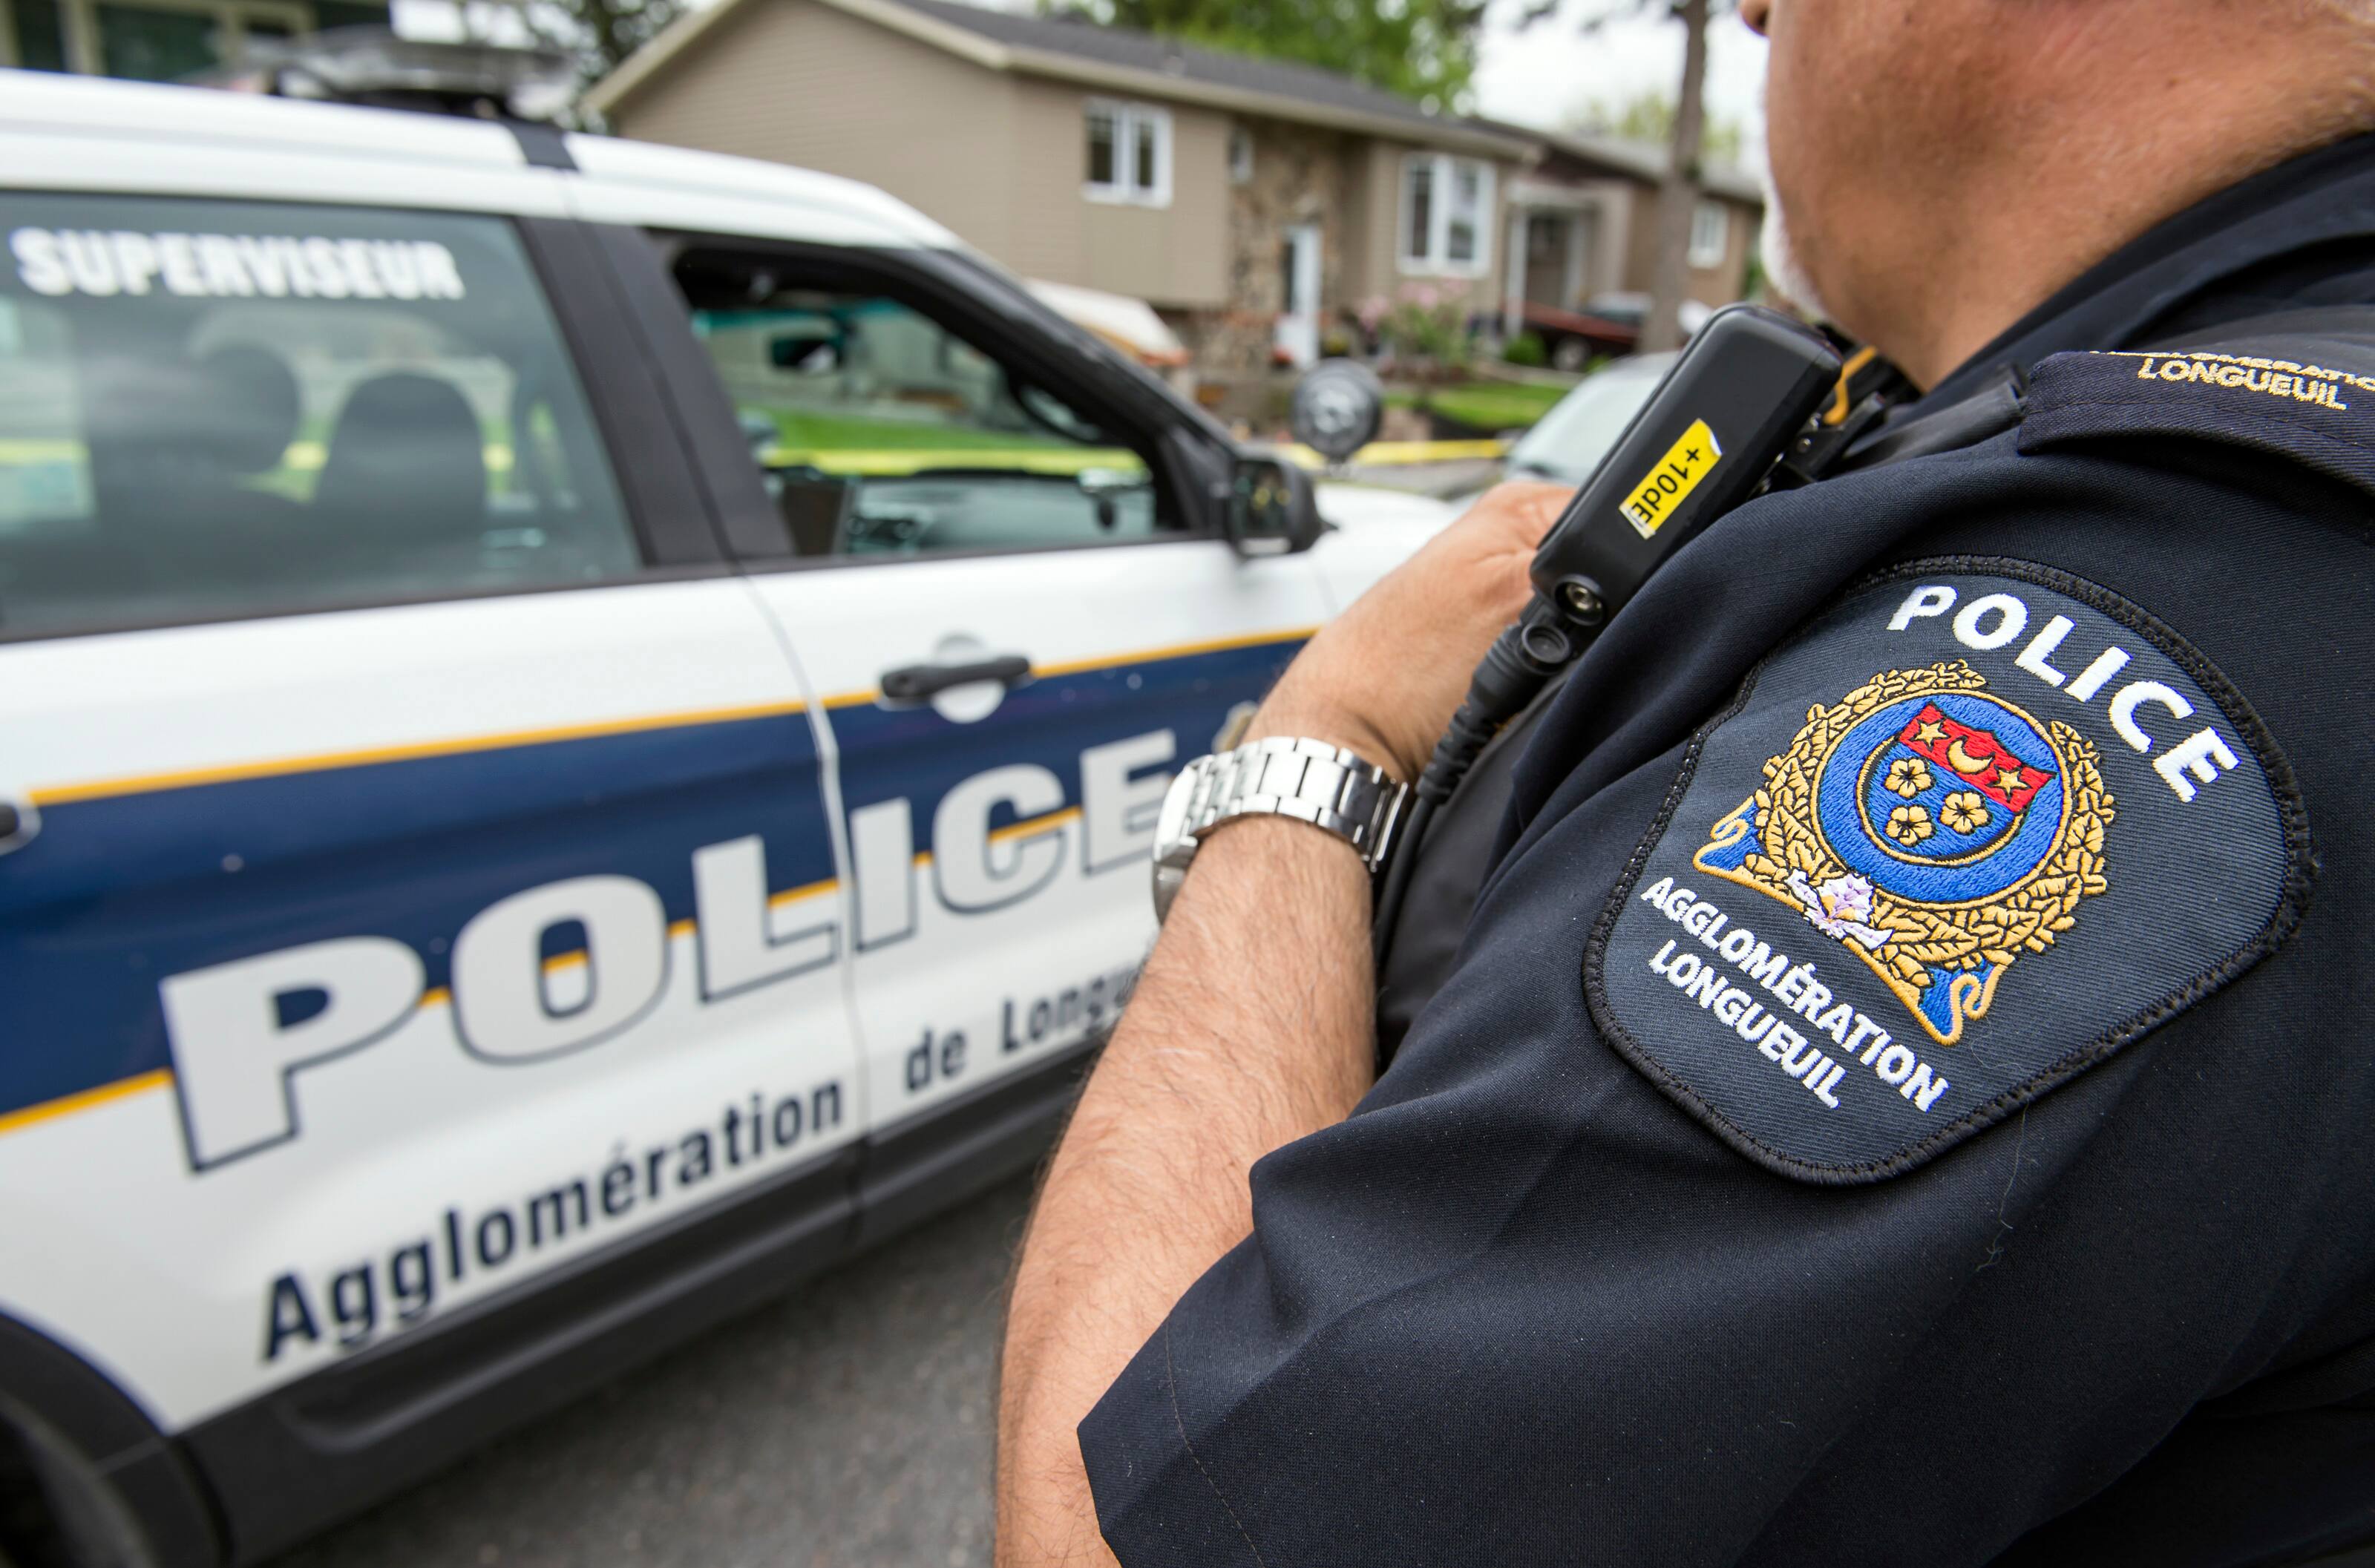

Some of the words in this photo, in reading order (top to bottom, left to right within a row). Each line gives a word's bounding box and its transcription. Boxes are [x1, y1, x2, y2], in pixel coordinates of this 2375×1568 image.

[10, 227, 466, 298] SUPERVISEUR
[2138, 357, 2348, 411] LONGUEUIL
[1886, 584, 2239, 804] POLICE
[158, 729, 1179, 1174] POLICE
[1639, 876, 1948, 1113] AGGLOMÉRATION
[1648, 939, 1848, 1109] LONGUEUIL
[260, 1079, 844, 1364] Agglomération
[905, 1026, 967, 1092] de
